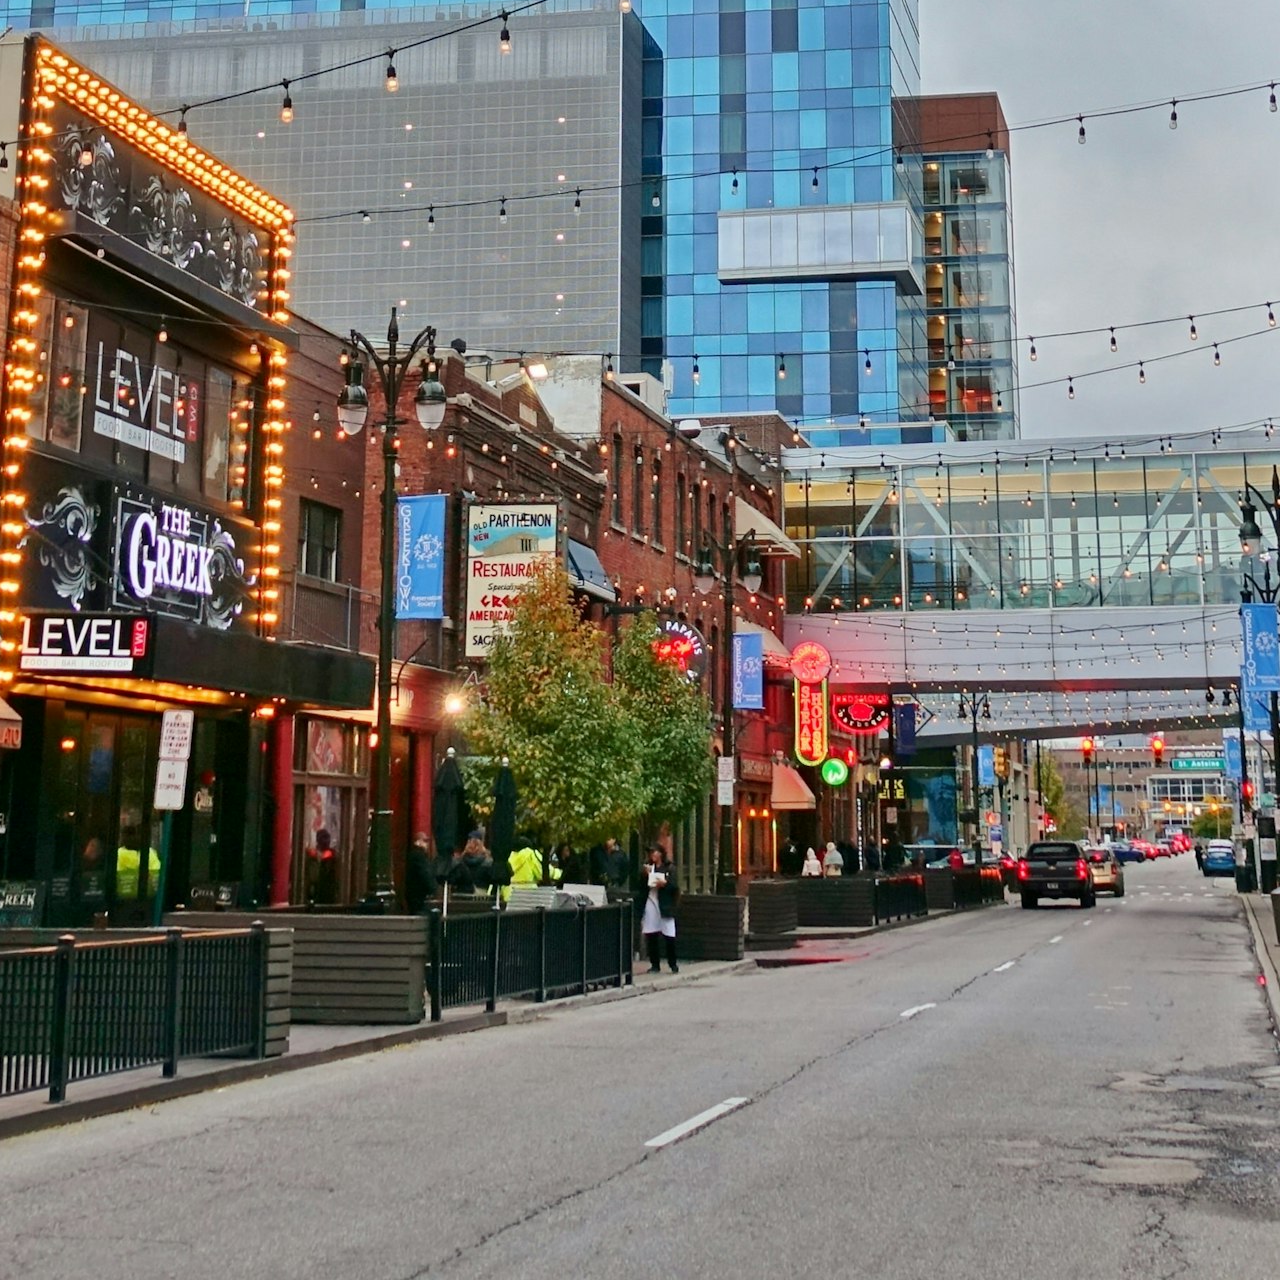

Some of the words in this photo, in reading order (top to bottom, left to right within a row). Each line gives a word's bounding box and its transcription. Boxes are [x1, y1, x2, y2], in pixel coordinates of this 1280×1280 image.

[95, 340, 186, 439] LEVEL
[161, 504, 192, 537] THE
[473, 522, 488, 531] OLD
[473, 532, 489, 542] NEW
[489, 513, 552, 528] PARTHENON
[128, 512, 215, 599] GREEK
[21, 618, 131, 657] LEVEL
[133, 619, 148, 657] TWO
[25, 659, 49, 667] FOOD
[61, 659, 77, 668] BAR
[89, 660, 130, 669] ROOFTOP
[801, 685, 812, 751] STEAK
[811, 692, 823, 758] HOUSE
